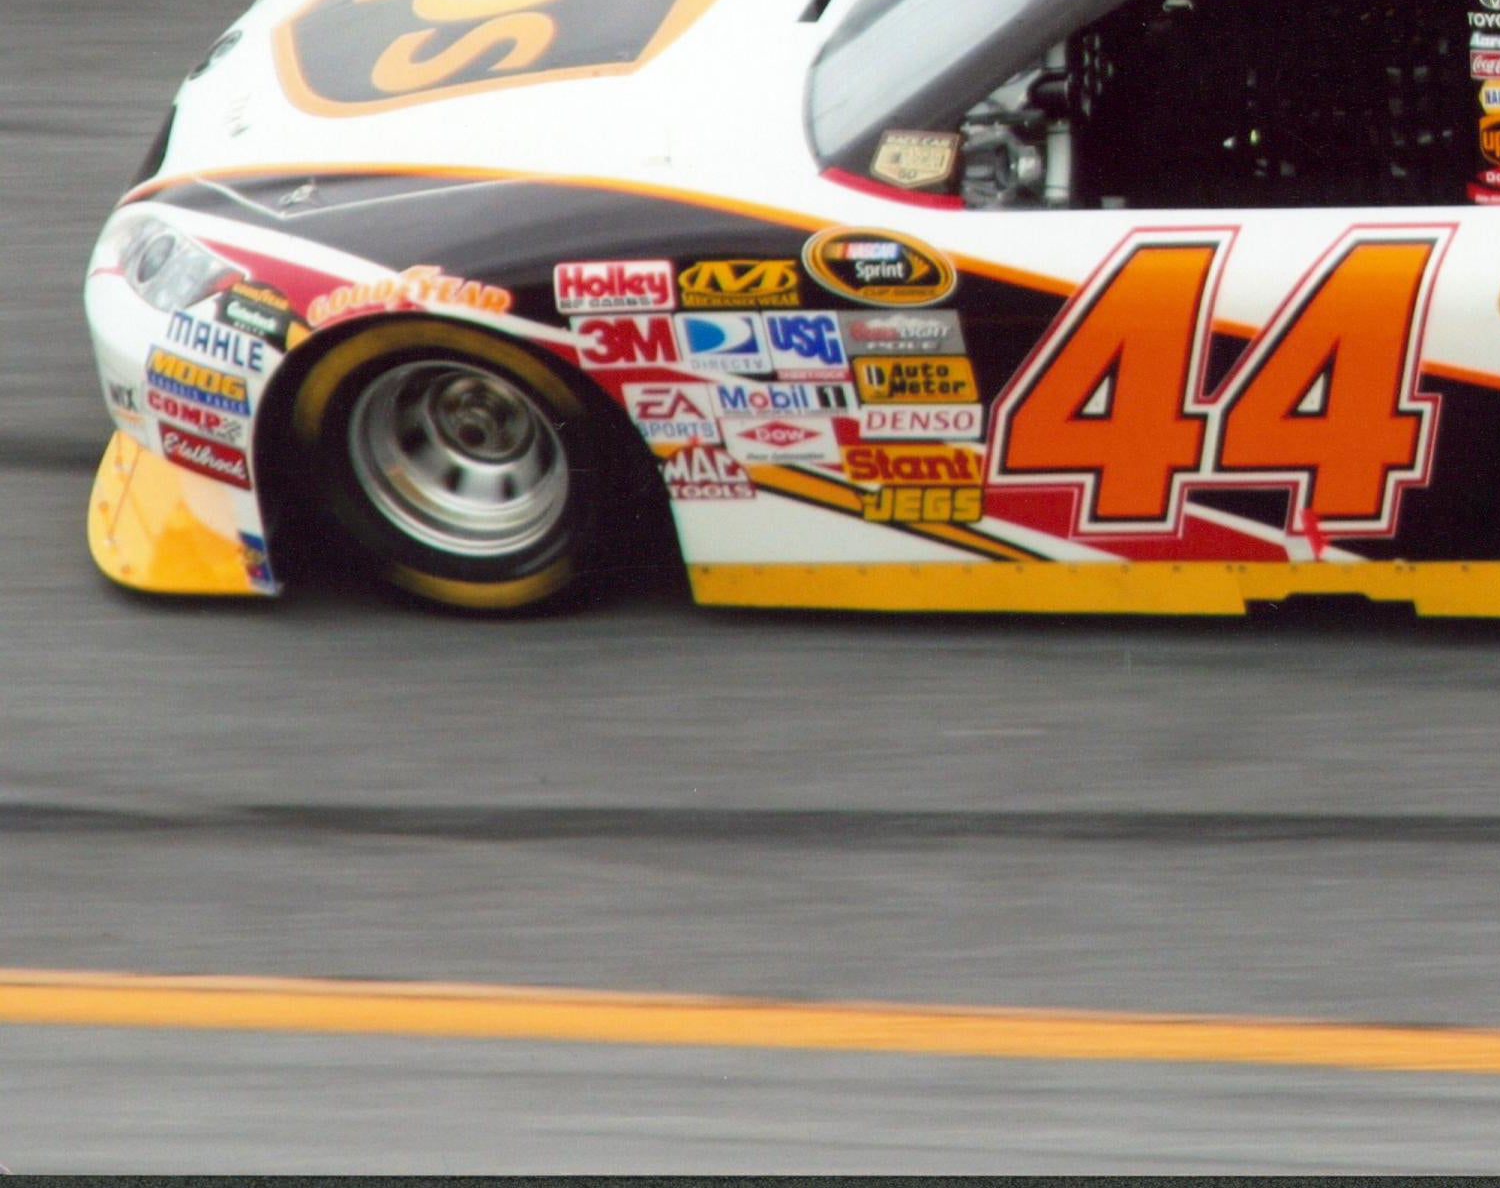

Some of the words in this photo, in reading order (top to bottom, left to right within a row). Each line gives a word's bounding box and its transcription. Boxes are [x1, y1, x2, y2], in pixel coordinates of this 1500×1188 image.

[557, 266, 669, 305] Holley
[854, 261, 904, 282] Sprint
[306, 265, 512, 328] GOODYEAR
[166, 311, 264, 373] MAHLE
[578, 316, 679, 364] 3M
[767, 315, 844, 365] USG
[151, 347, 247, 402] MOOG
[691, 358, 764, 370] DIRECTV
[892, 363, 949, 379] Auto
[986, 223, 1460, 539] 44
[635, 386, 707, 421] EA
[717, 384, 809, 410] Mobil
[890, 379, 967, 396] Meter
[148, 388, 222, 431] COMP
[865, 410, 974, 432] DENSO
[639, 422, 715, 439] SPORTS
[662, 446, 749, 484] MAC
[846, 447, 974, 480] Stant
[669, 484, 755, 499] TOOLS
[863, 486, 983, 523] JEGS
